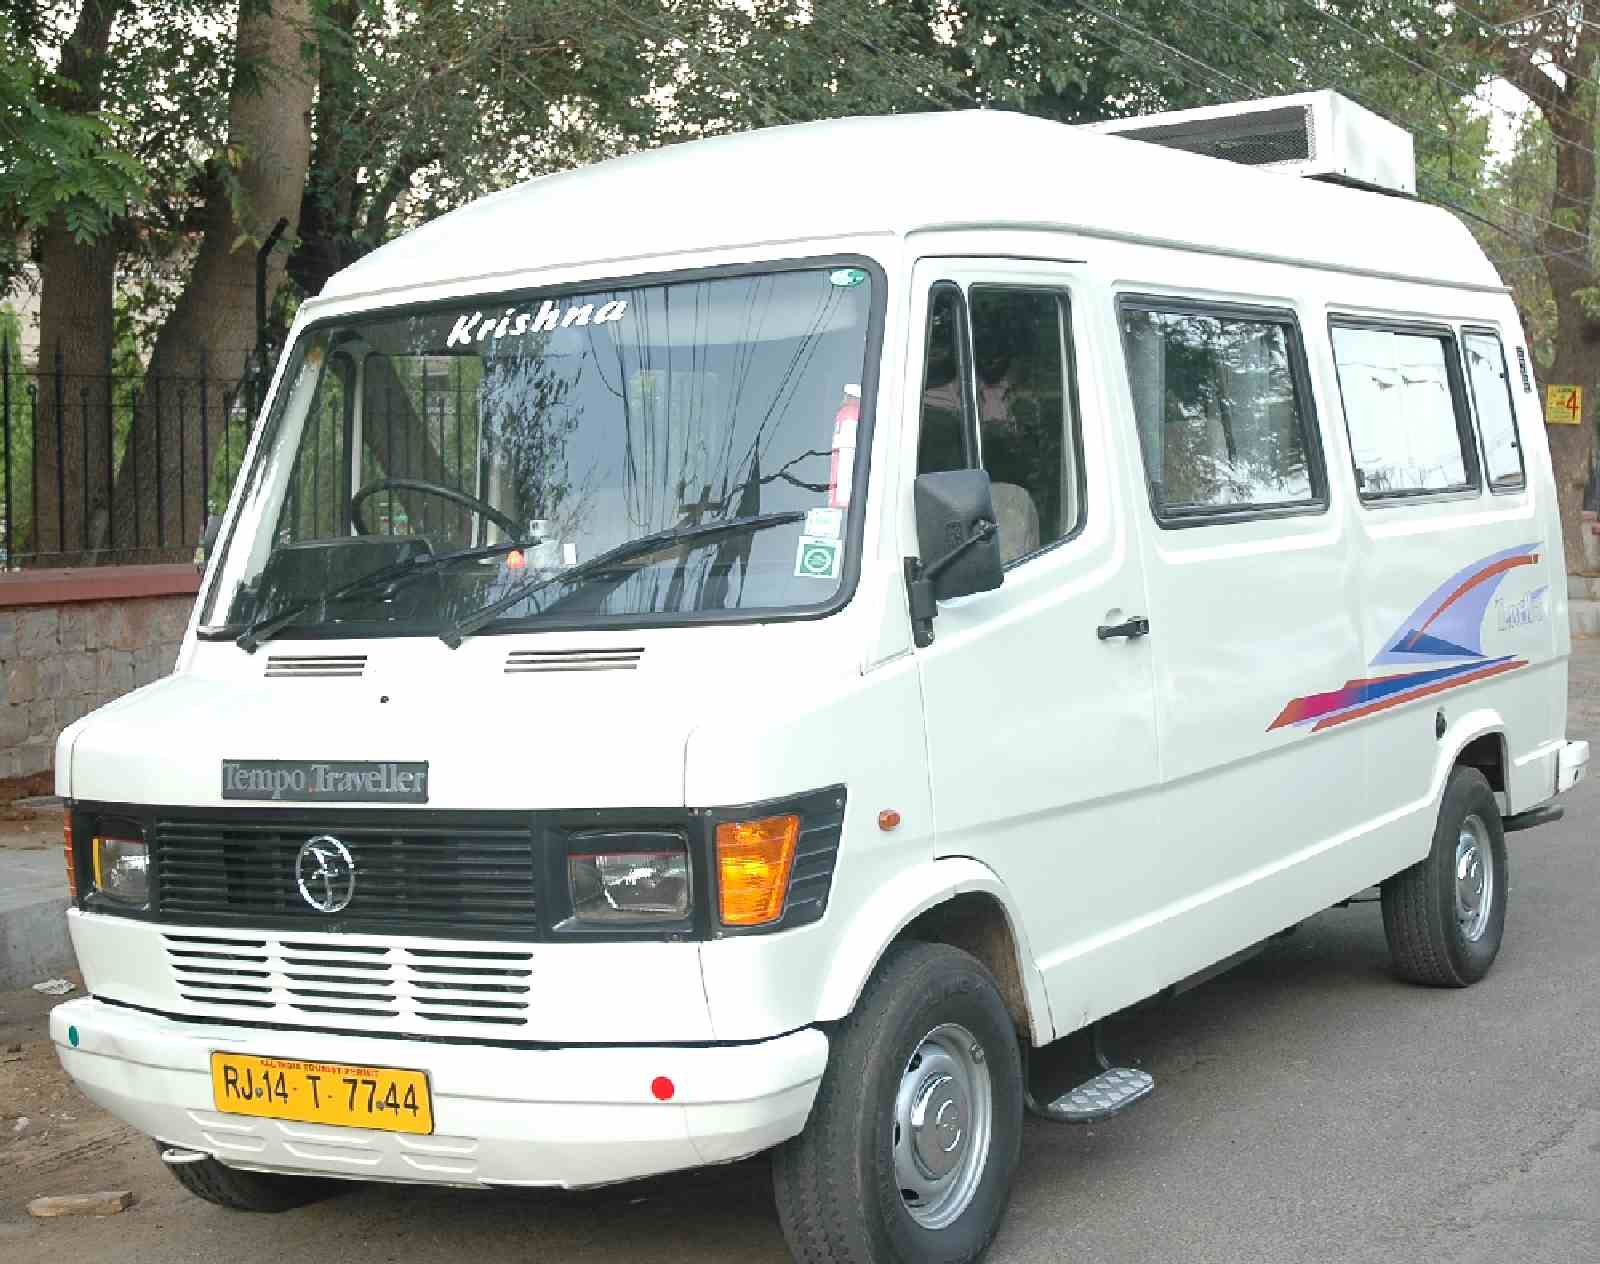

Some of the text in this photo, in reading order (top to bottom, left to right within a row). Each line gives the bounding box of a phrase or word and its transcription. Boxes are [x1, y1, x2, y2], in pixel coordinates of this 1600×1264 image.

[446, 300, 628, 347] Krishna
[223, 763, 425, 799] Tempo Traveller
